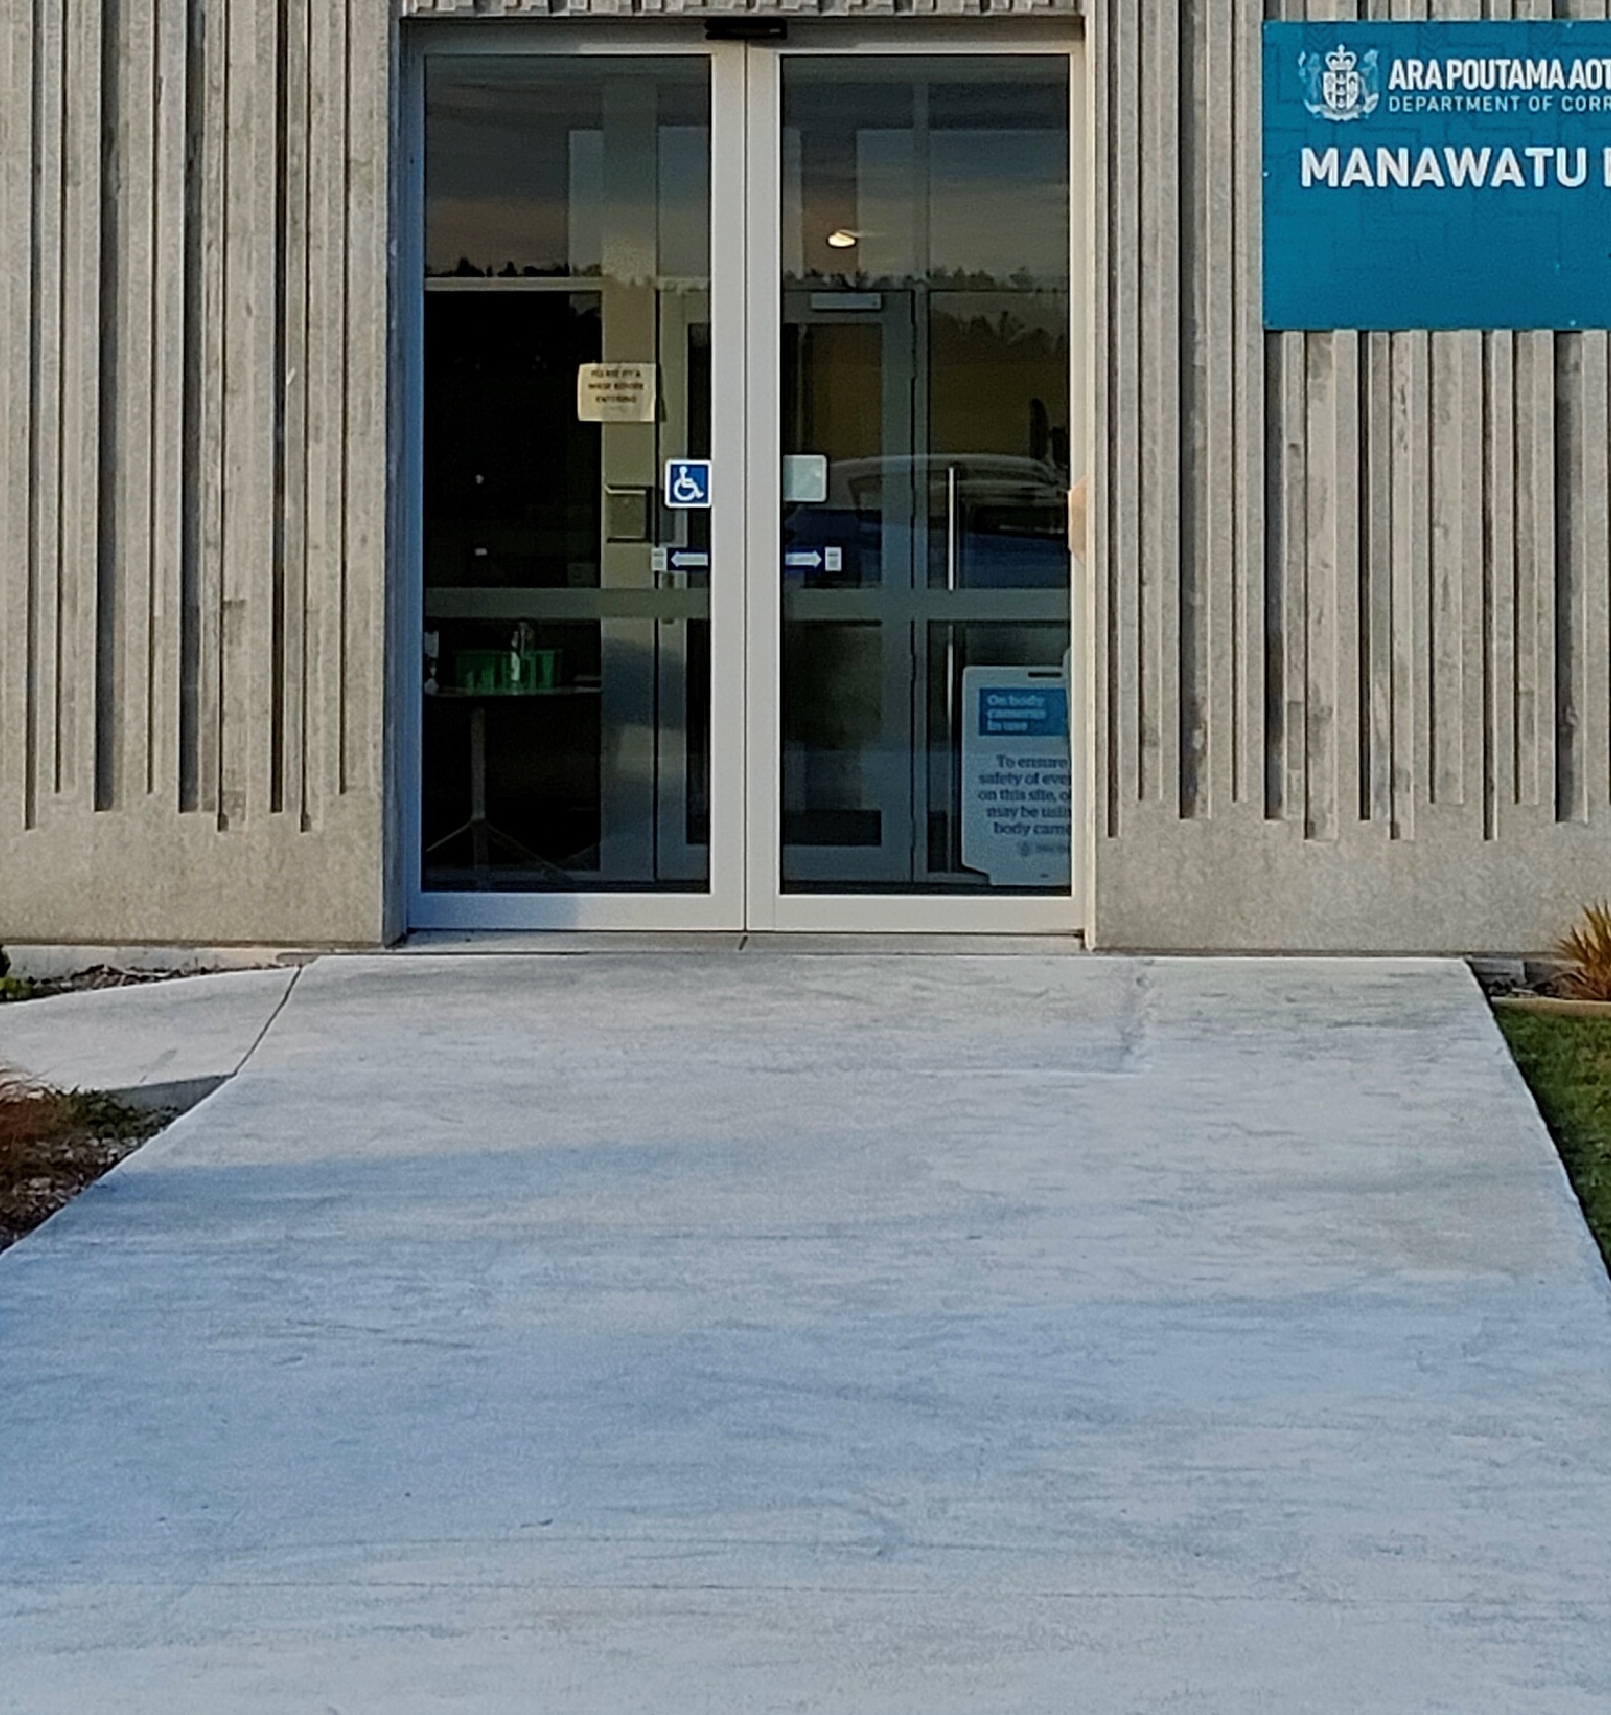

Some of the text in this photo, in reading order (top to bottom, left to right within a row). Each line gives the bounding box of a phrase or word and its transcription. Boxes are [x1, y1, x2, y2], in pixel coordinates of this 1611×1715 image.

[1389, 59, 1443, 90] ARA
[1447, 59, 1565, 90] POUTAMA
[1389, 95, 1521, 112] DEPARTMENT
[1528, 95, 1553, 112] OF
[1300, 147, 1587, 188] MANAWATU
[1009, 694, 1045, 707] body
[996, 754, 1069, 769] To ensure
[978, 772, 1022, 786] safety
[1025, 772, 1039, 785] of
[978, 790, 997, 801] on
[1000, 789, 1026, 801] this
[987, 807, 1019, 821] may
[1021, 806, 1039, 818] be
[994, 821, 1031, 836] body
